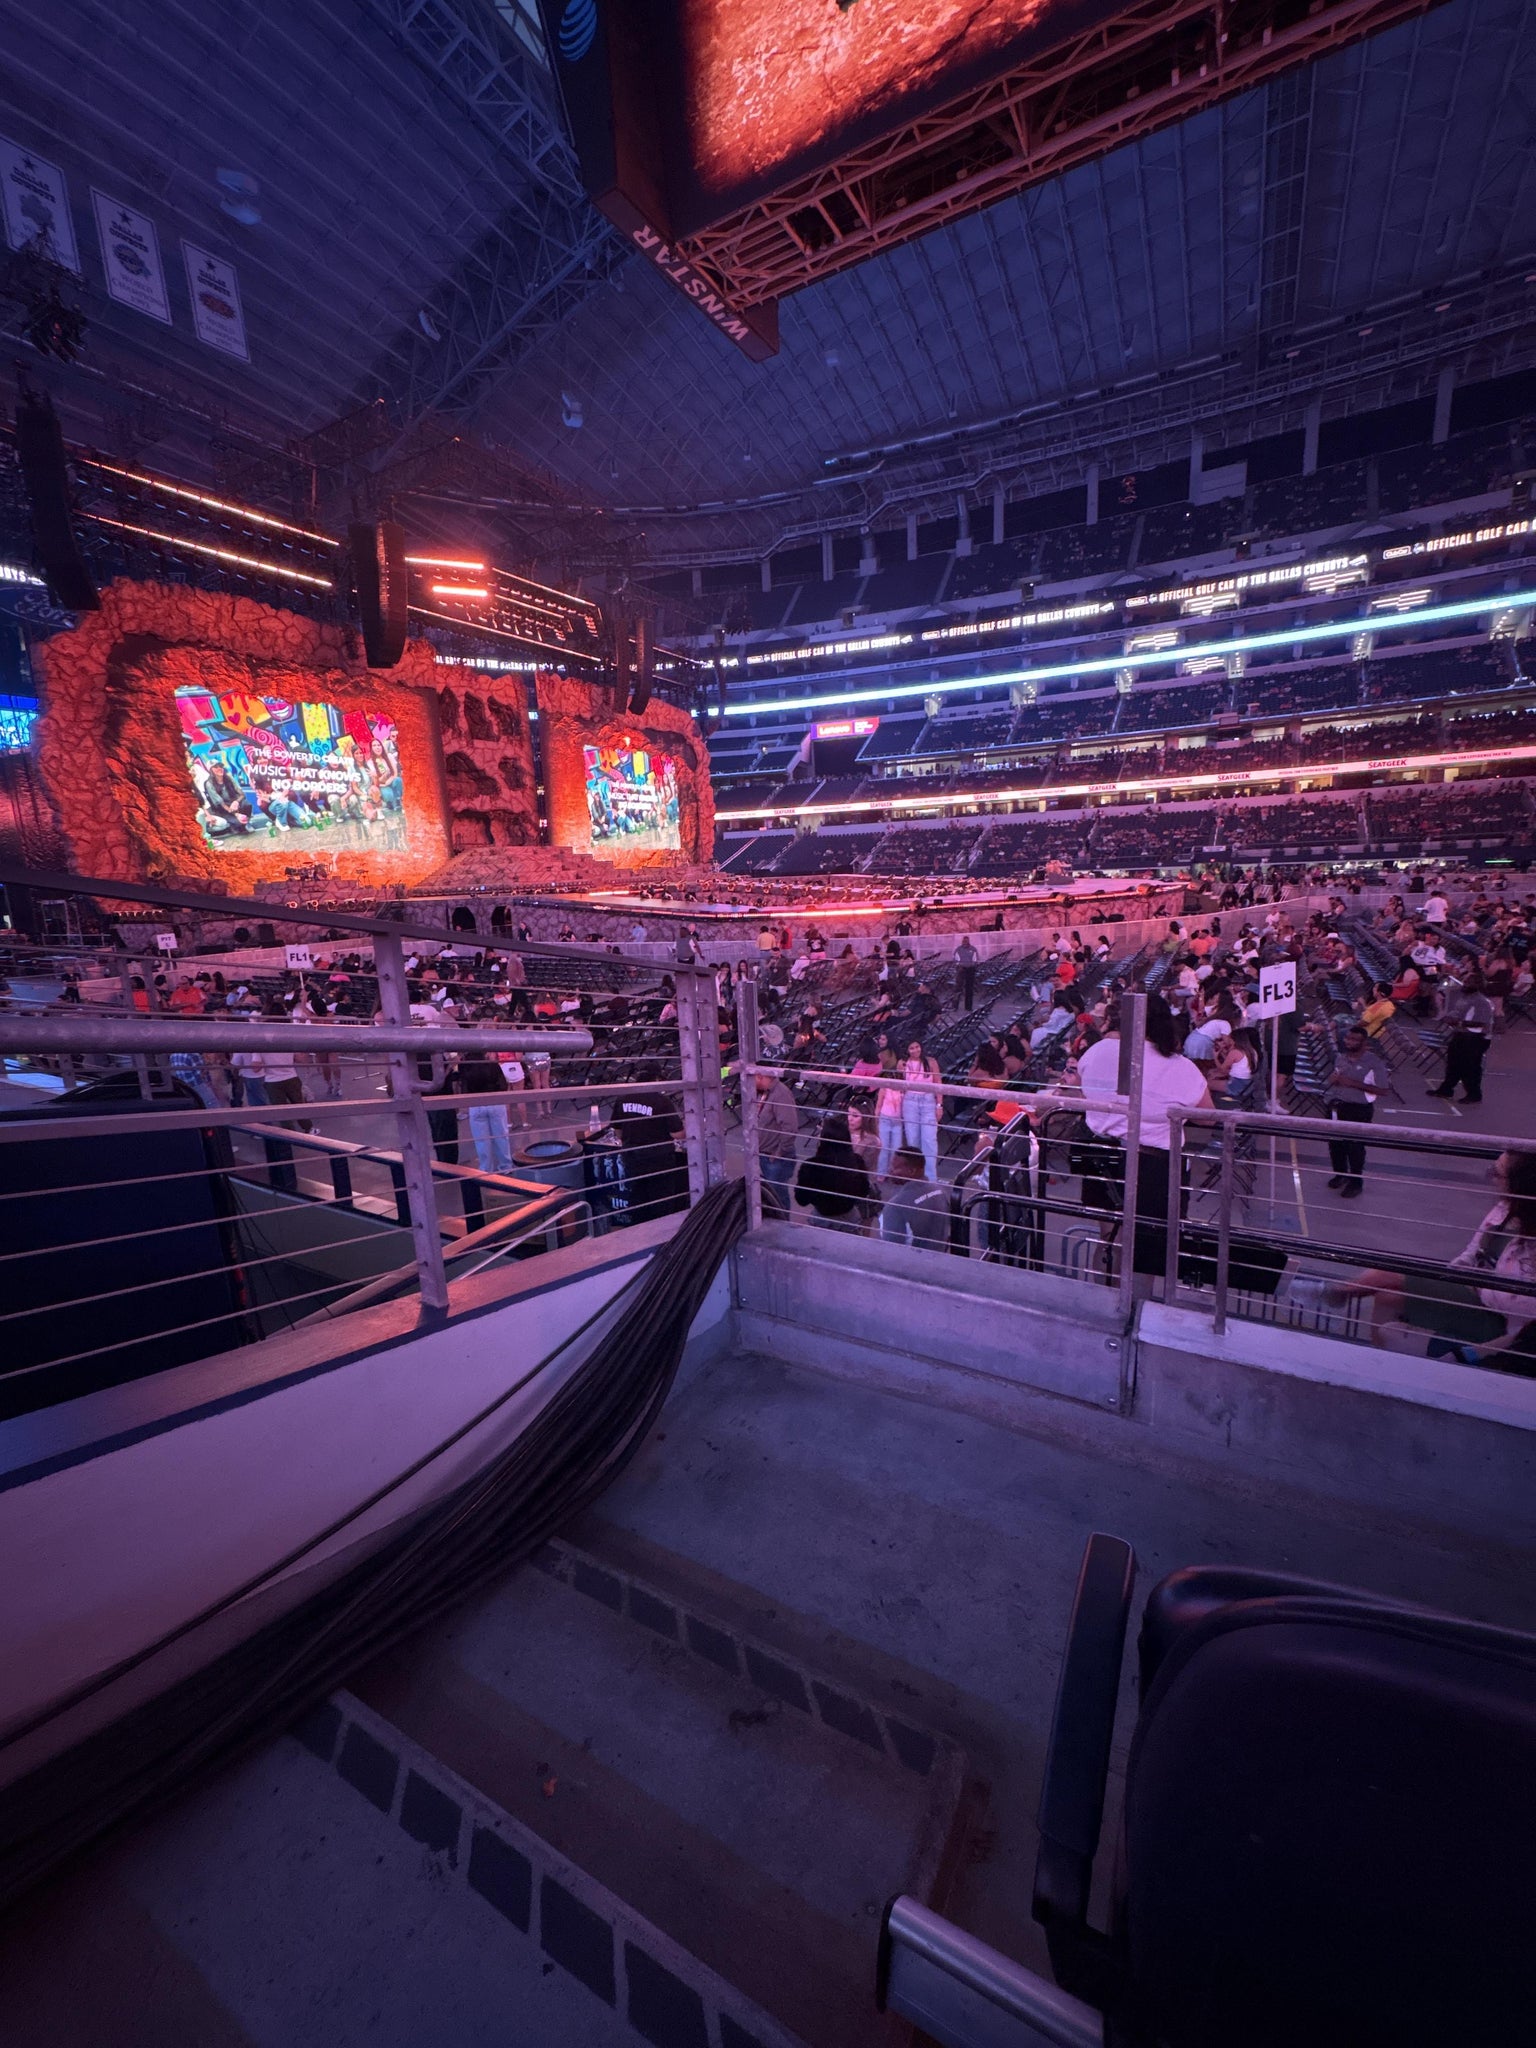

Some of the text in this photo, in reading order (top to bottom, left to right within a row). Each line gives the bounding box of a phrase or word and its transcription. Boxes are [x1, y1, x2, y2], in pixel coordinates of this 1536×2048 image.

[1426, 533, 1472, 552] OFFICIAL
[1476, 526, 1503, 542] GOLF
[1506, 520, 1529, 536] CAR
[1159, 587, 1194, 602] OFFICIAL
[1196, 583, 1216, 595] GOLF
[1218, 580, 1234, 592] CAR
[1237, 577, 1248, 588] OF
[1250, 573, 1267, 585] THE
[1268, 566, 1301, 583] DALLAS
[1303, 557, 1349, 576] COWBOYS
[949, 624, 977, 637] OFFICIAL
[979, 621, 995, 633] GOLF
[997, 618, 1010, 629] CAR
[1011, 616, 1021, 627] OF
[1023, 614, 1036, 625] THE
[254, 748, 272, 759] THE
[274, 750, 307, 761] POWER
[309, 754, 321, 762] TO
[1368, 759, 1407, 769] SEATGEEK
[248, 765, 361, 783] MUSIC THAT KNOWS
[271, 778, 347, 793] NO BORDERS
[289, 952, 308, 962] FL1
[1263, 980, 1294, 1004] FL3
[622, 1102, 653, 1117] VENDOR
[611, 1197, 630, 1209] Lite
